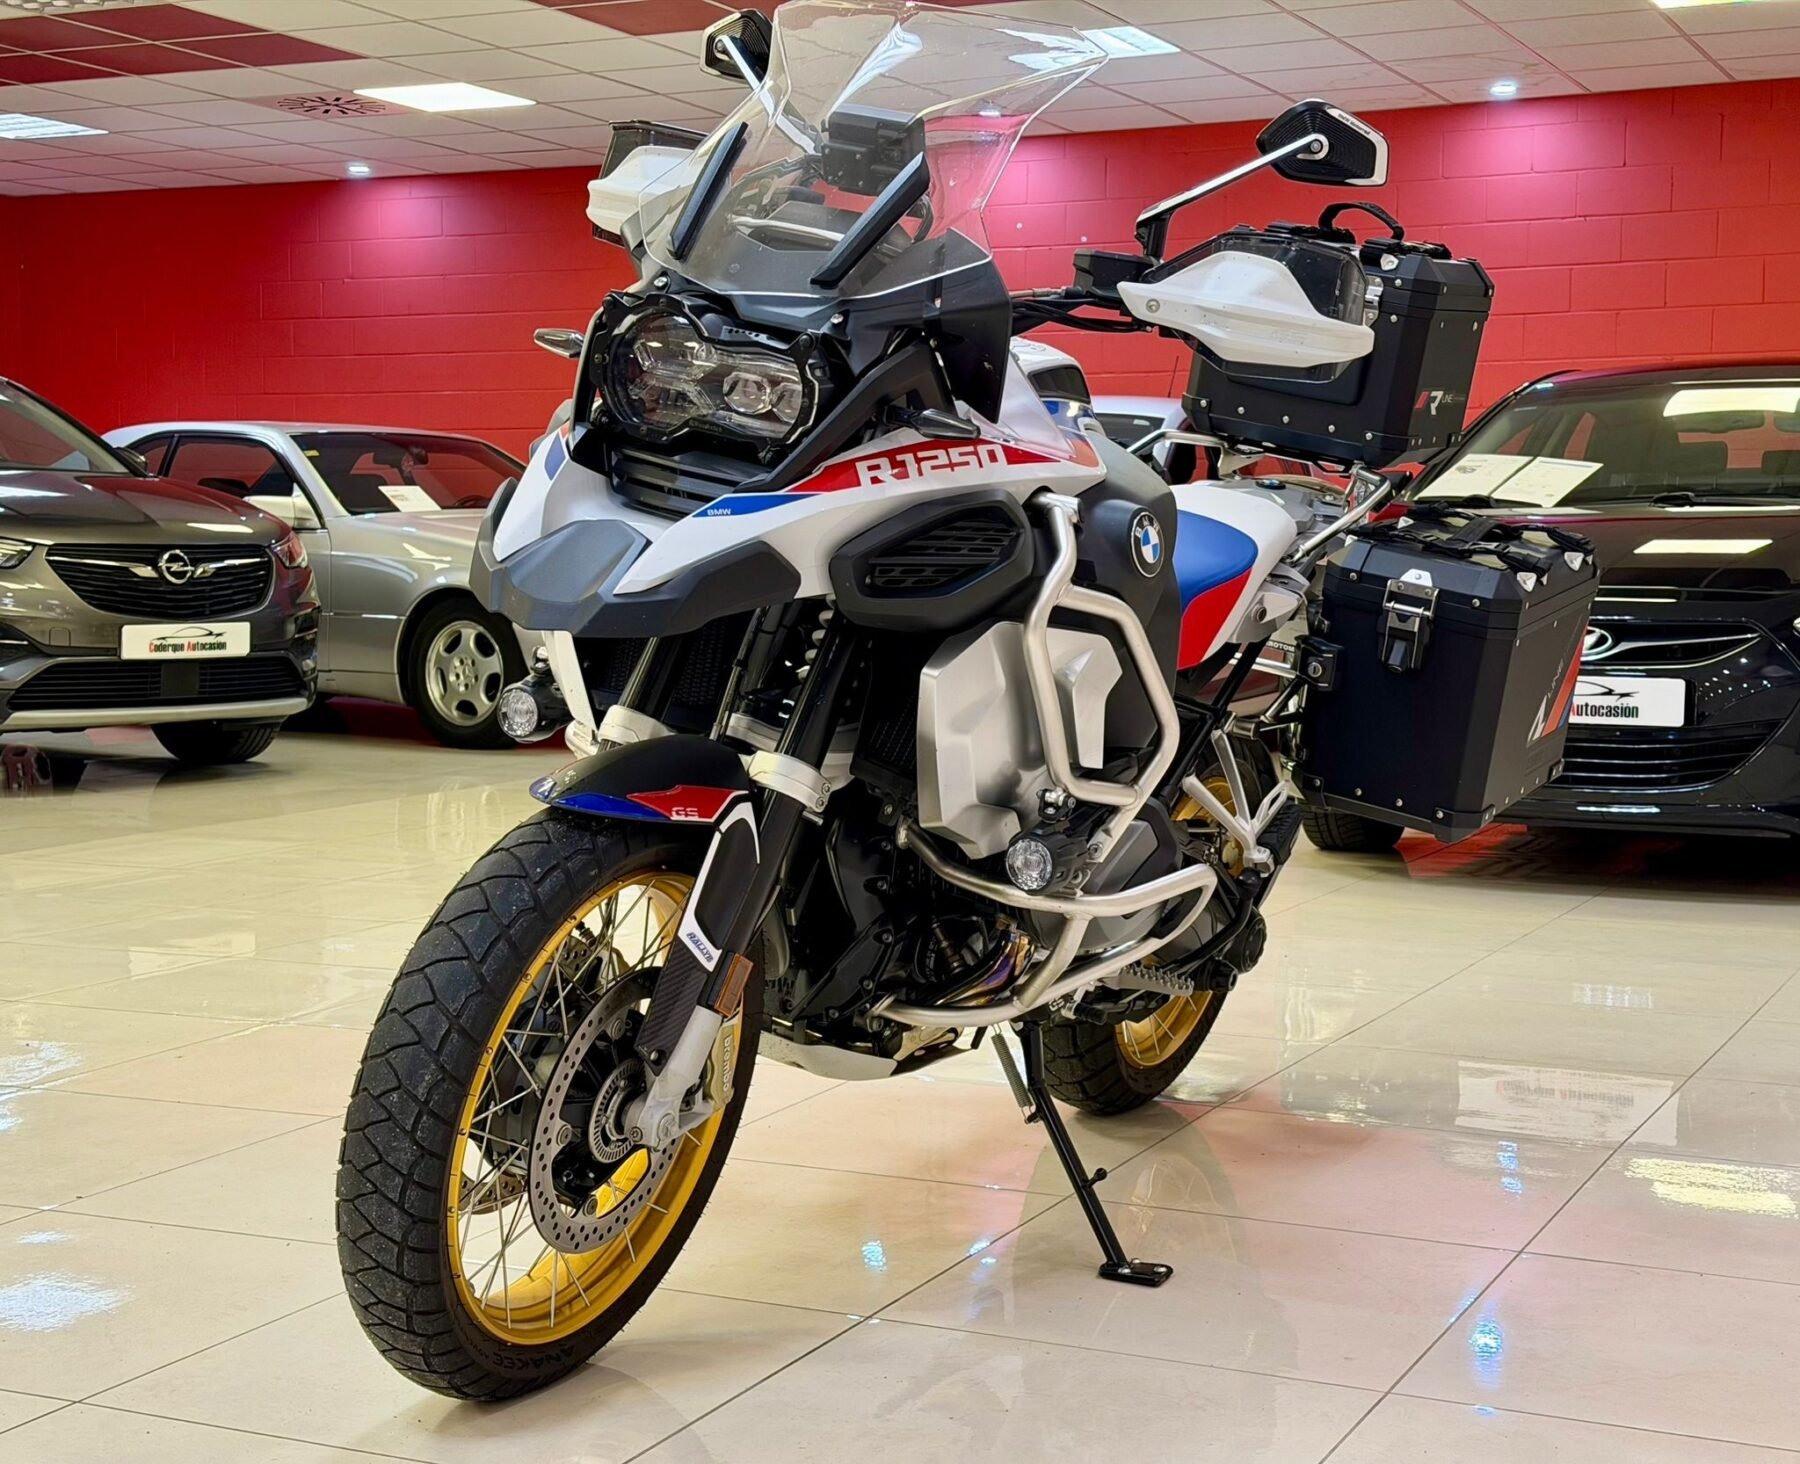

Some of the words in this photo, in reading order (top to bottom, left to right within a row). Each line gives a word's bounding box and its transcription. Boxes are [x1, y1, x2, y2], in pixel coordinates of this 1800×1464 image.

[706, 508, 732, 516] BMW
[1134, 515, 1160, 538] BMW
[671, 806, 699, 819] GS
[686, 932, 714, 963] RALLYE
[722, 1034, 733, 1093] brembo
